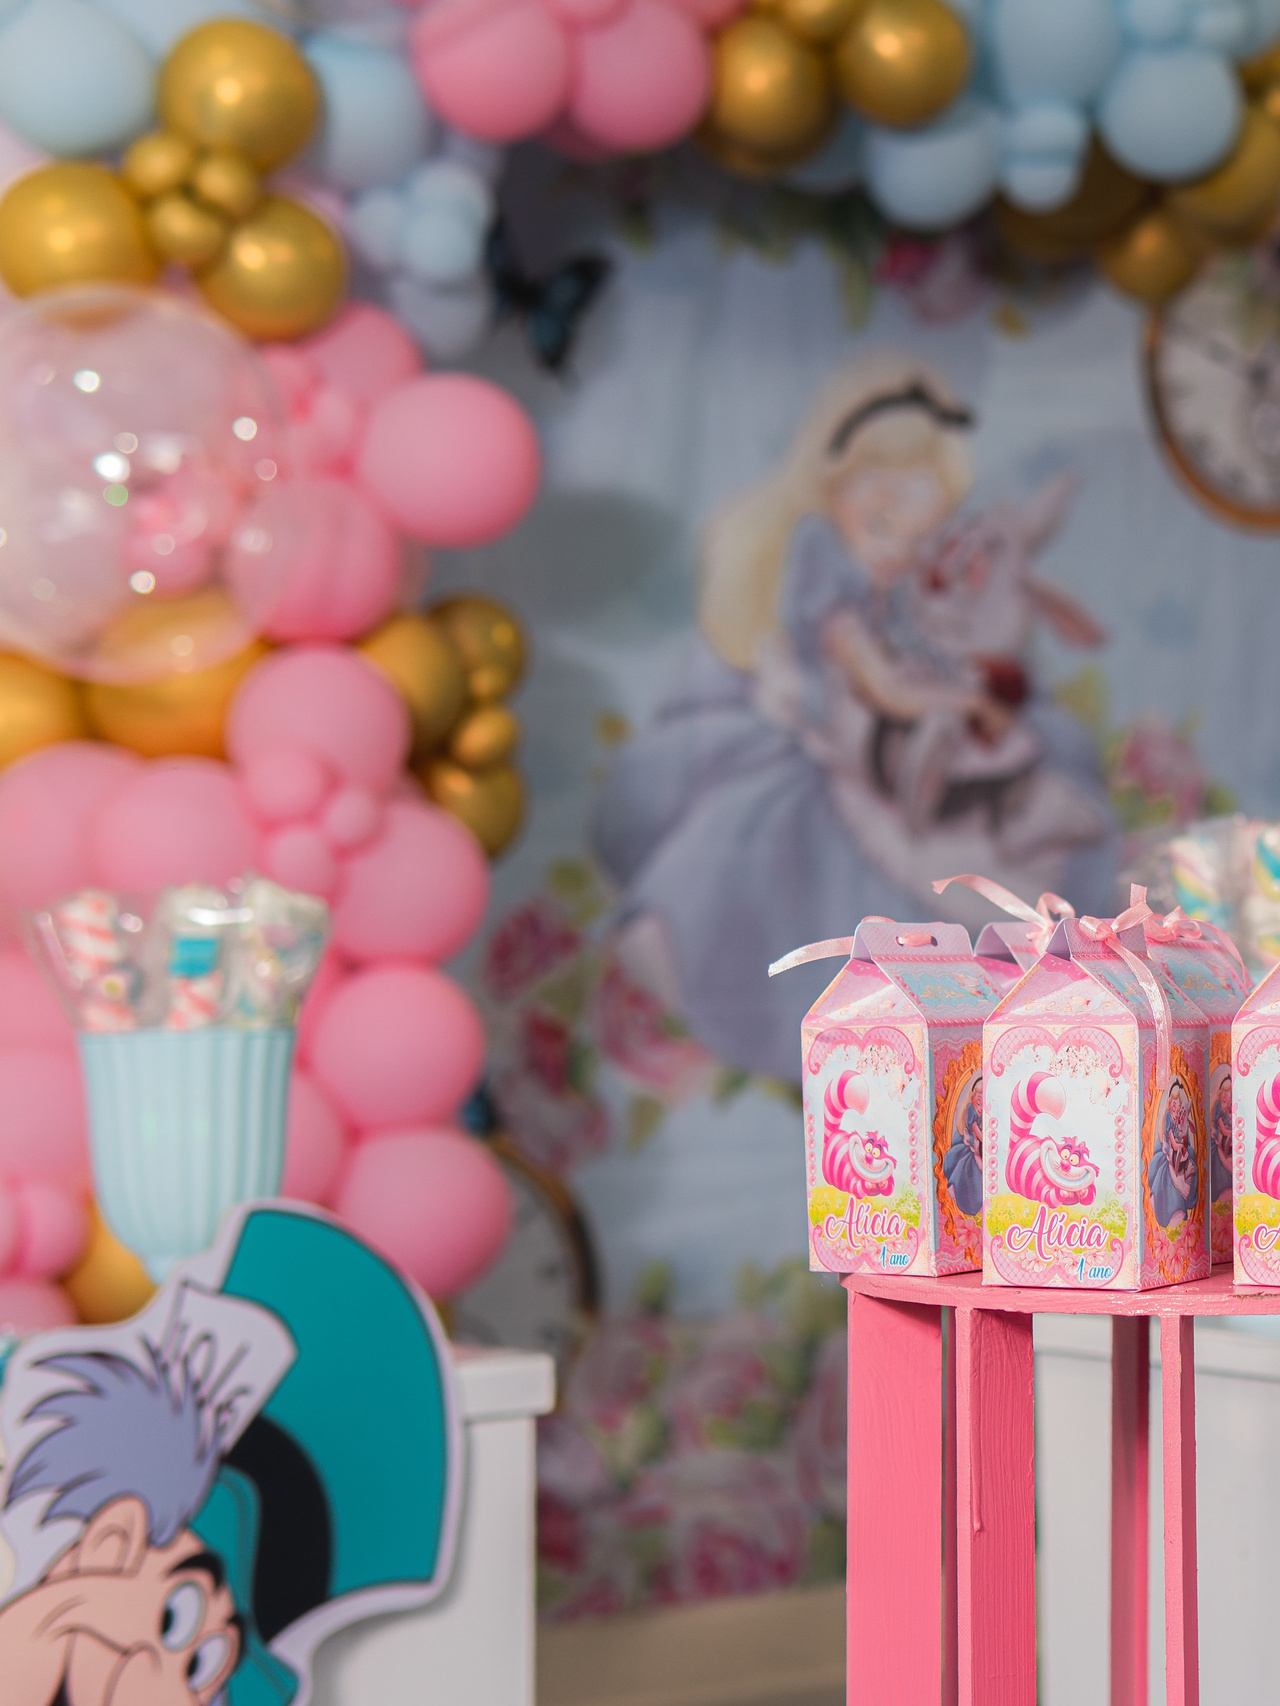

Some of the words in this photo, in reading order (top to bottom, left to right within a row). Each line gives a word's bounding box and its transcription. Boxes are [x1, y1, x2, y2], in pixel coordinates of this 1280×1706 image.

[1006, 1205, 1108, 1261] Alícia
[880, 1244, 887, 1269] 1
[889, 1253, 910, 1266] ano
[1076, 1257, 1086, 1281] 1
[1088, 1265, 1114, 1279] ano
